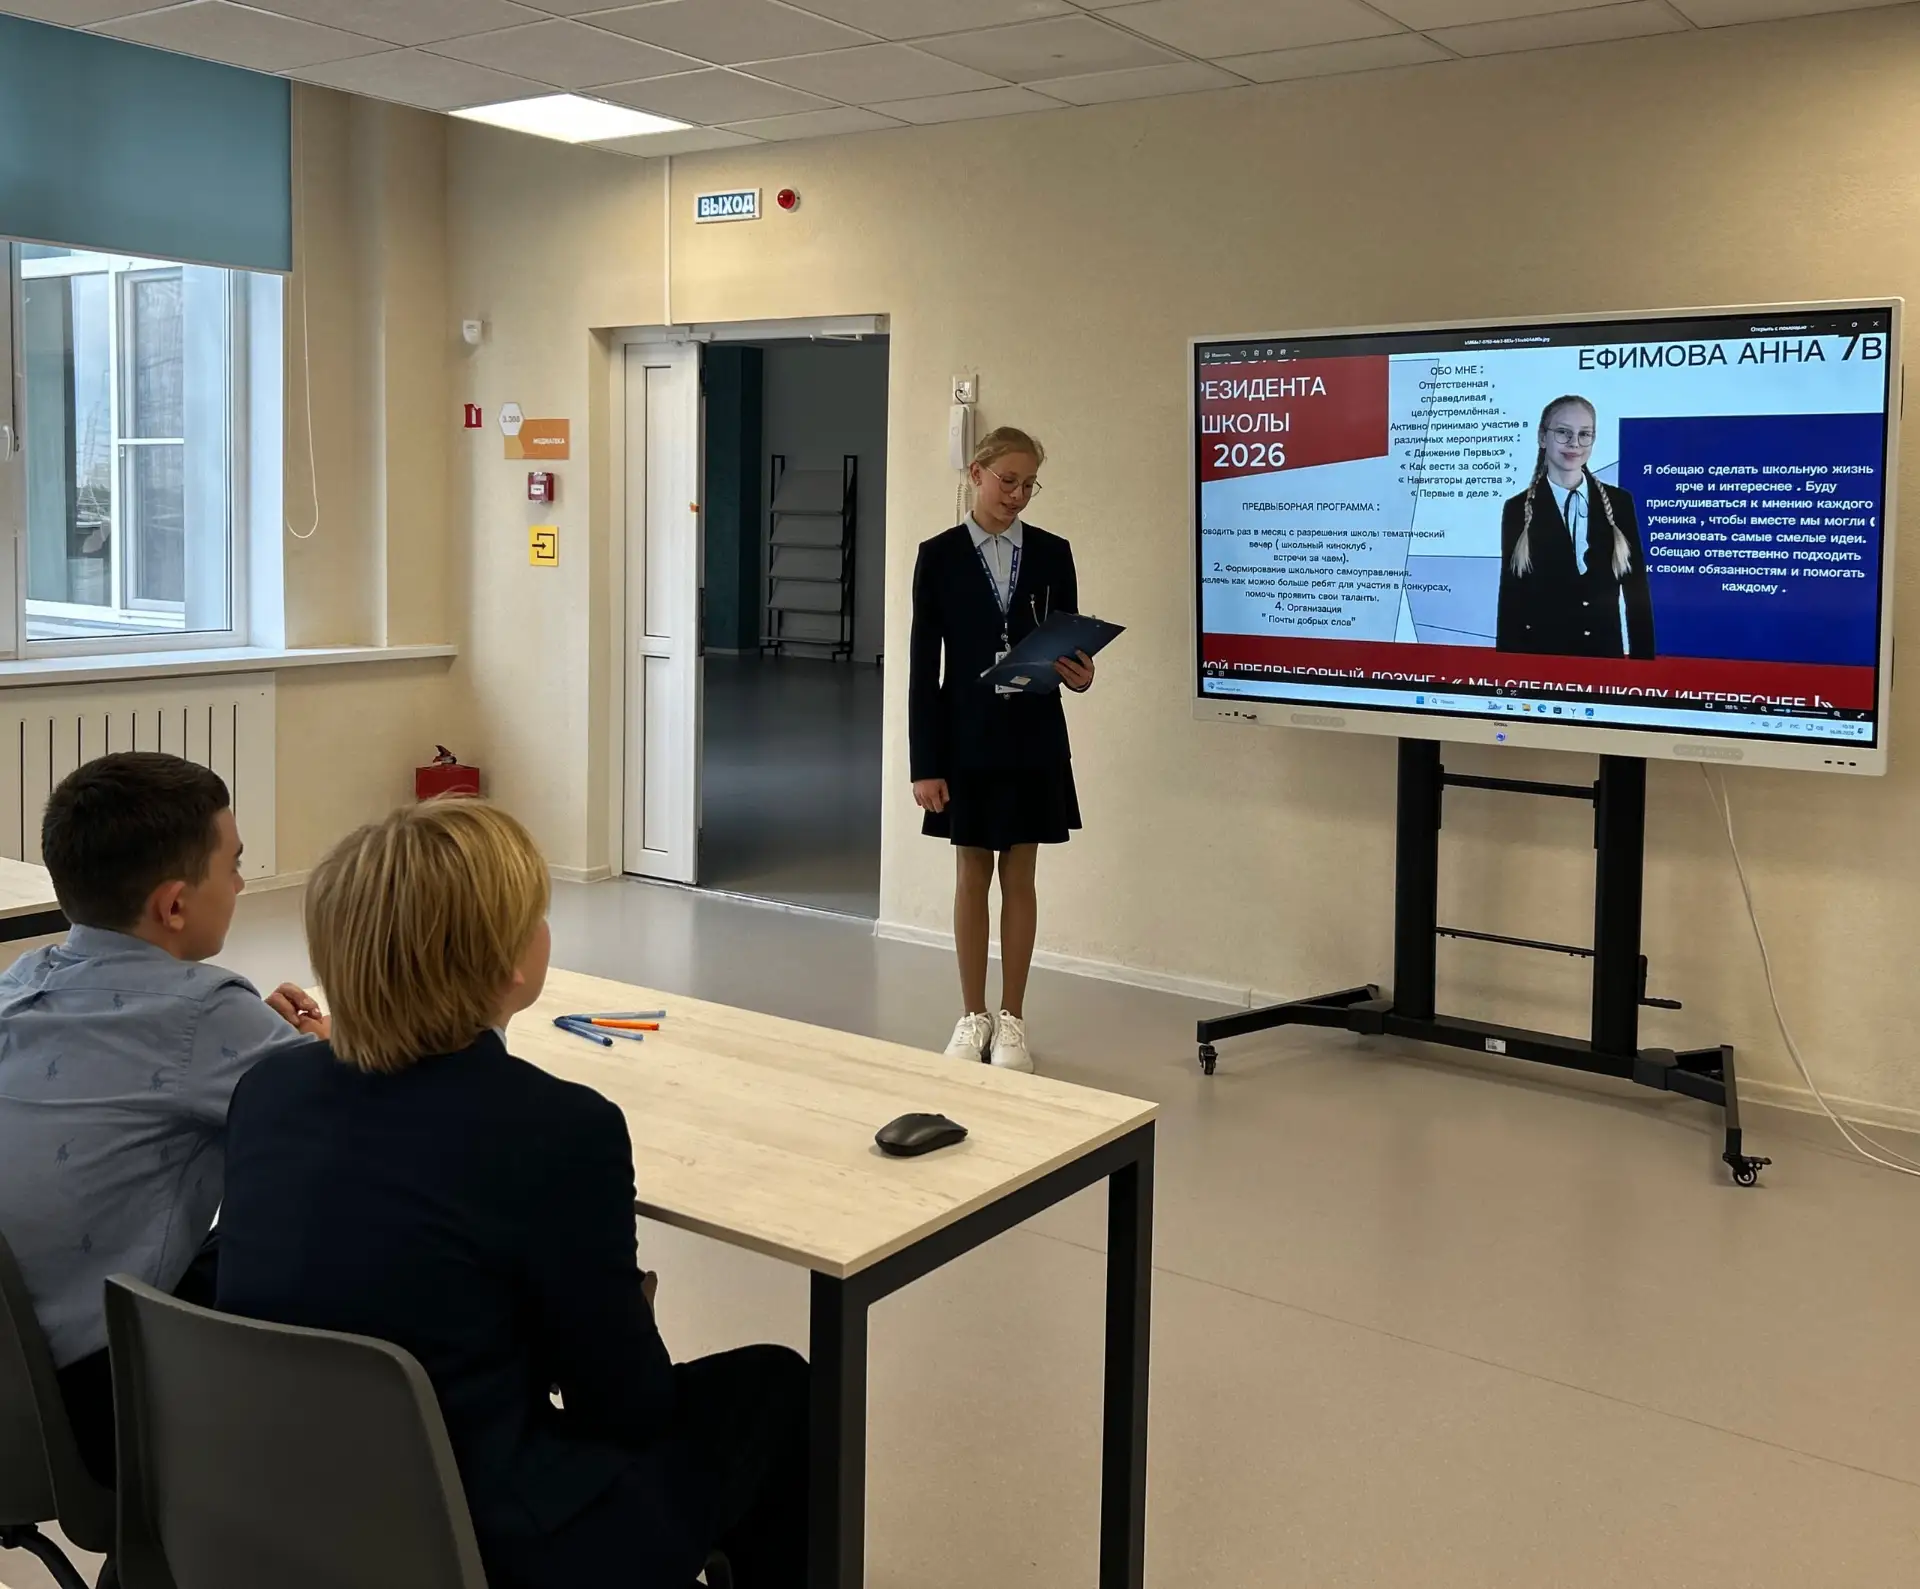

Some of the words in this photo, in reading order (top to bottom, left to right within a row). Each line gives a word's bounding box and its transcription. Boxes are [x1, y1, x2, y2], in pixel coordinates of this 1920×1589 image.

[701, 194, 753, 215] ВЫХОД
[1579, 344, 1728, 370] ЕФИМОВА
[1738, 340, 1825, 364] АННА
[1838, 334, 1882, 361] 7В
[1430, 366, 1452, 376] ОБО
[1454, 366, 1477, 374] МНЕ
[1418, 380, 1489, 390] Ответственная
[1420, 394, 1487, 404] справедливая
[1411, 407, 1500, 418] целеустремлённая
[1202, 412, 1290, 434] ШКОЛЫ
[1390, 422, 1428, 431] Активно
[1430, 422, 1478, 432] принимаю
[1482, 422, 1520, 432] участие
[1394, 436, 1444, 446] различных
[1446, 434, 1514, 445] мероприятиях
[1213, 442, 1286, 468] 2026
[1414, 448, 1460, 458] Движение
[1464, 448, 1506, 458] Первых»
[1409, 462, 1427, 470] Как
[1429, 463, 1456, 471] вести
[1472, 462, 1501, 470] собой
[1643, 465, 1652, 475] Я
[1656, 464, 1704, 476] обещаю
[1708, 465, 1758, 476] сделать
[1762, 465, 1828, 477] школьную
[1832, 464, 1874, 475] жизнь
[1408, 476, 1462, 485] Навигаторы
[1465, 476, 1502, 484] детства
[1675, 482, 1704, 493] ярче
[1708, 483, 1716, 492] и
[1720, 482, 1792, 493] интереснее
[1806, 480, 1837, 494] Буду
[1420, 489, 1455, 498] Первые
[1466, 490, 1490, 498] деле
[1242, 502, 1314, 512] ПРЕДВЫБОРНАЯ
[1316, 502, 1374, 512] ПРОГРАММА
[1646, 499, 1747, 511] прислушиваться
[1750, 500, 1758, 508] к
[1762, 500, 1813, 509] мнению
[1817, 500, 1874, 511] каждого
[1648, 514, 1697, 526] ученика
[1708, 514, 1747, 525] чтобы
[1750, 516, 1796, 526] вместе
[1800, 517, 1820, 526] мы
[1824, 517, 1866, 526] могли
[1201, 528, 1234, 536] оводить
[1237, 528, 1251, 537] раз
[1262, 529, 1286, 537] месяц
[1297, 529, 1348, 538] разрешения
[1350, 530, 1380, 538] школы
[1382, 530, 1445, 538] тематический
[1650, 531, 1727, 544] реализовать
[1732, 532, 1772, 542] самые
[1776, 533, 1826, 544] смелые
[1830, 534, 1867, 545] идеи.
[1249, 541, 1272, 550] вечер
[1282, 540, 1324, 548] школьный
[1326, 542, 1366, 551] киноклуб
[1274, 554, 1306, 562] встречи
[1650, 546, 1700, 558] Обещаю
[1704, 548, 1789, 560] ответственно
[1793, 550, 1862, 562] подходить
[1214, 562, 1223, 572] 2.
[1226, 564, 1286, 574] Формирование
[1288, 567, 1334, 575] школьного
[1336, 568, 1412, 578] самоуправления.
[1646, 564, 1653, 573] к
[1656, 564, 1694, 574] своим
[1698, 563, 1787, 577] обязанностям
[1791, 568, 1799, 576] и
[1802, 568, 1865, 579] помогать
[1278, 578, 1309, 586] больше
[1312, 579, 1336, 588] ребят
[1338, 581, 1354, 590] для
[1356, 582, 1390, 590] участия
[1402, 583, 1452, 593] конкурсах,
[1722, 583, 1778, 595] каждому
[1245, 590, 1276, 598] помочь
[1278, 592, 1316, 600] проявить
[1341, 594, 1380, 602] таланты.
[1275, 602, 1284, 611] 4.
[1287, 603, 1342, 614] Организация
[1268, 615, 1294, 624] Почты
[1297, 617, 1328, 626] добрых
